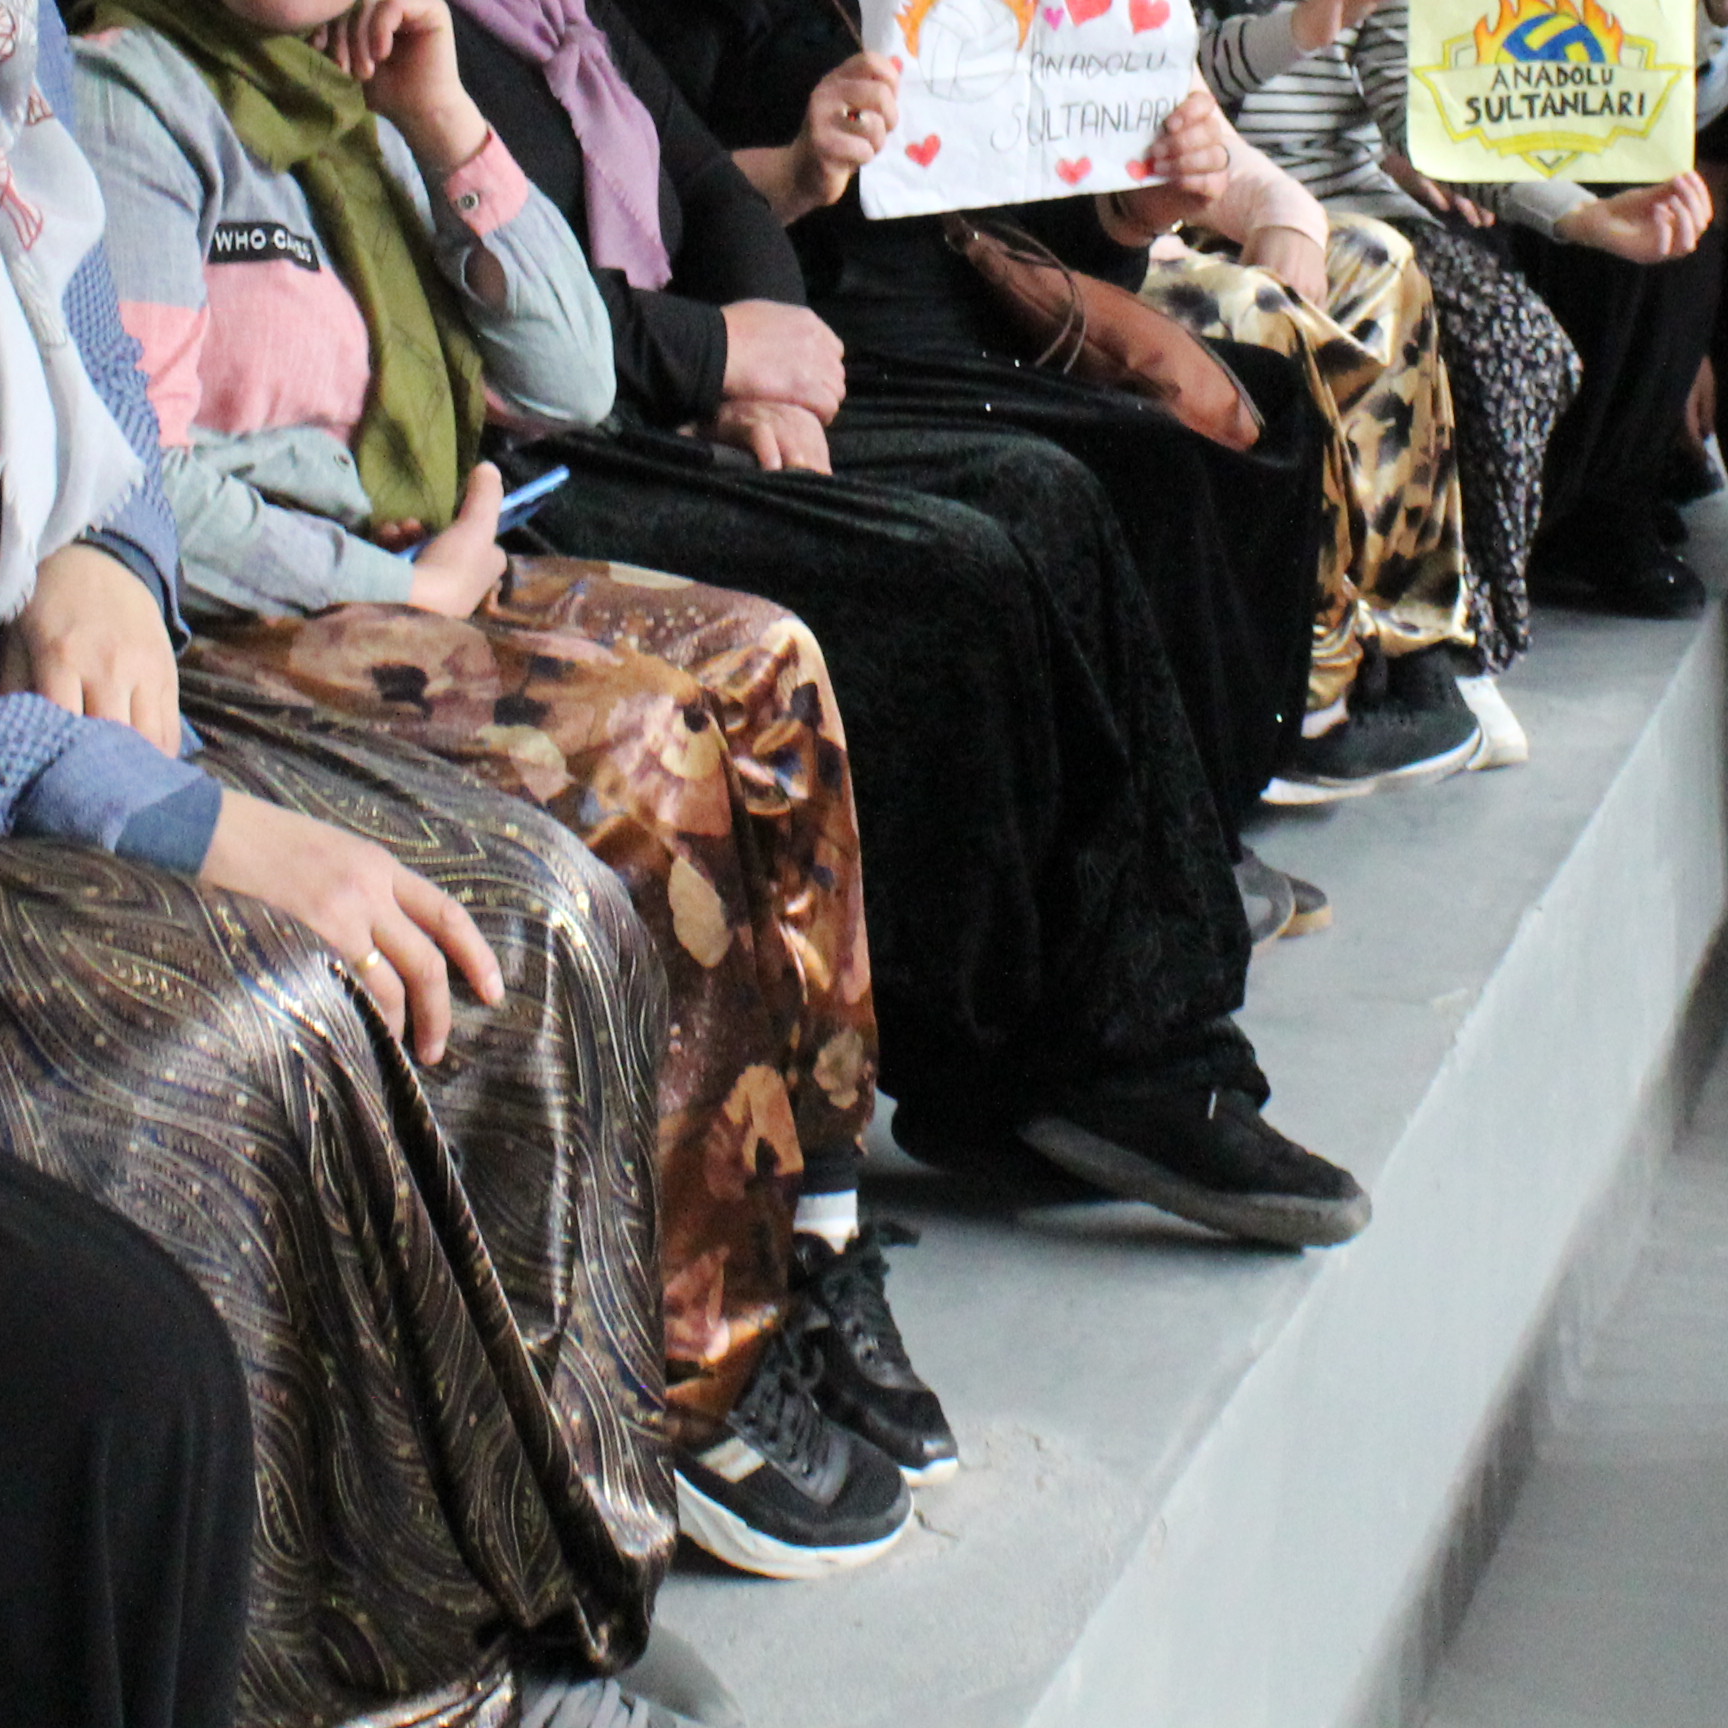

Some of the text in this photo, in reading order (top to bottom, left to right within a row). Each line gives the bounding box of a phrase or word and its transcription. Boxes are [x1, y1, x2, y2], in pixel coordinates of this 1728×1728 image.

[1030, 49, 1166, 80] ANADOLU
[1489, 63, 1614, 91] ANADOLU
[1465, 90, 1646, 125] SULTANLARI
[214, 228, 267, 252] WHO
